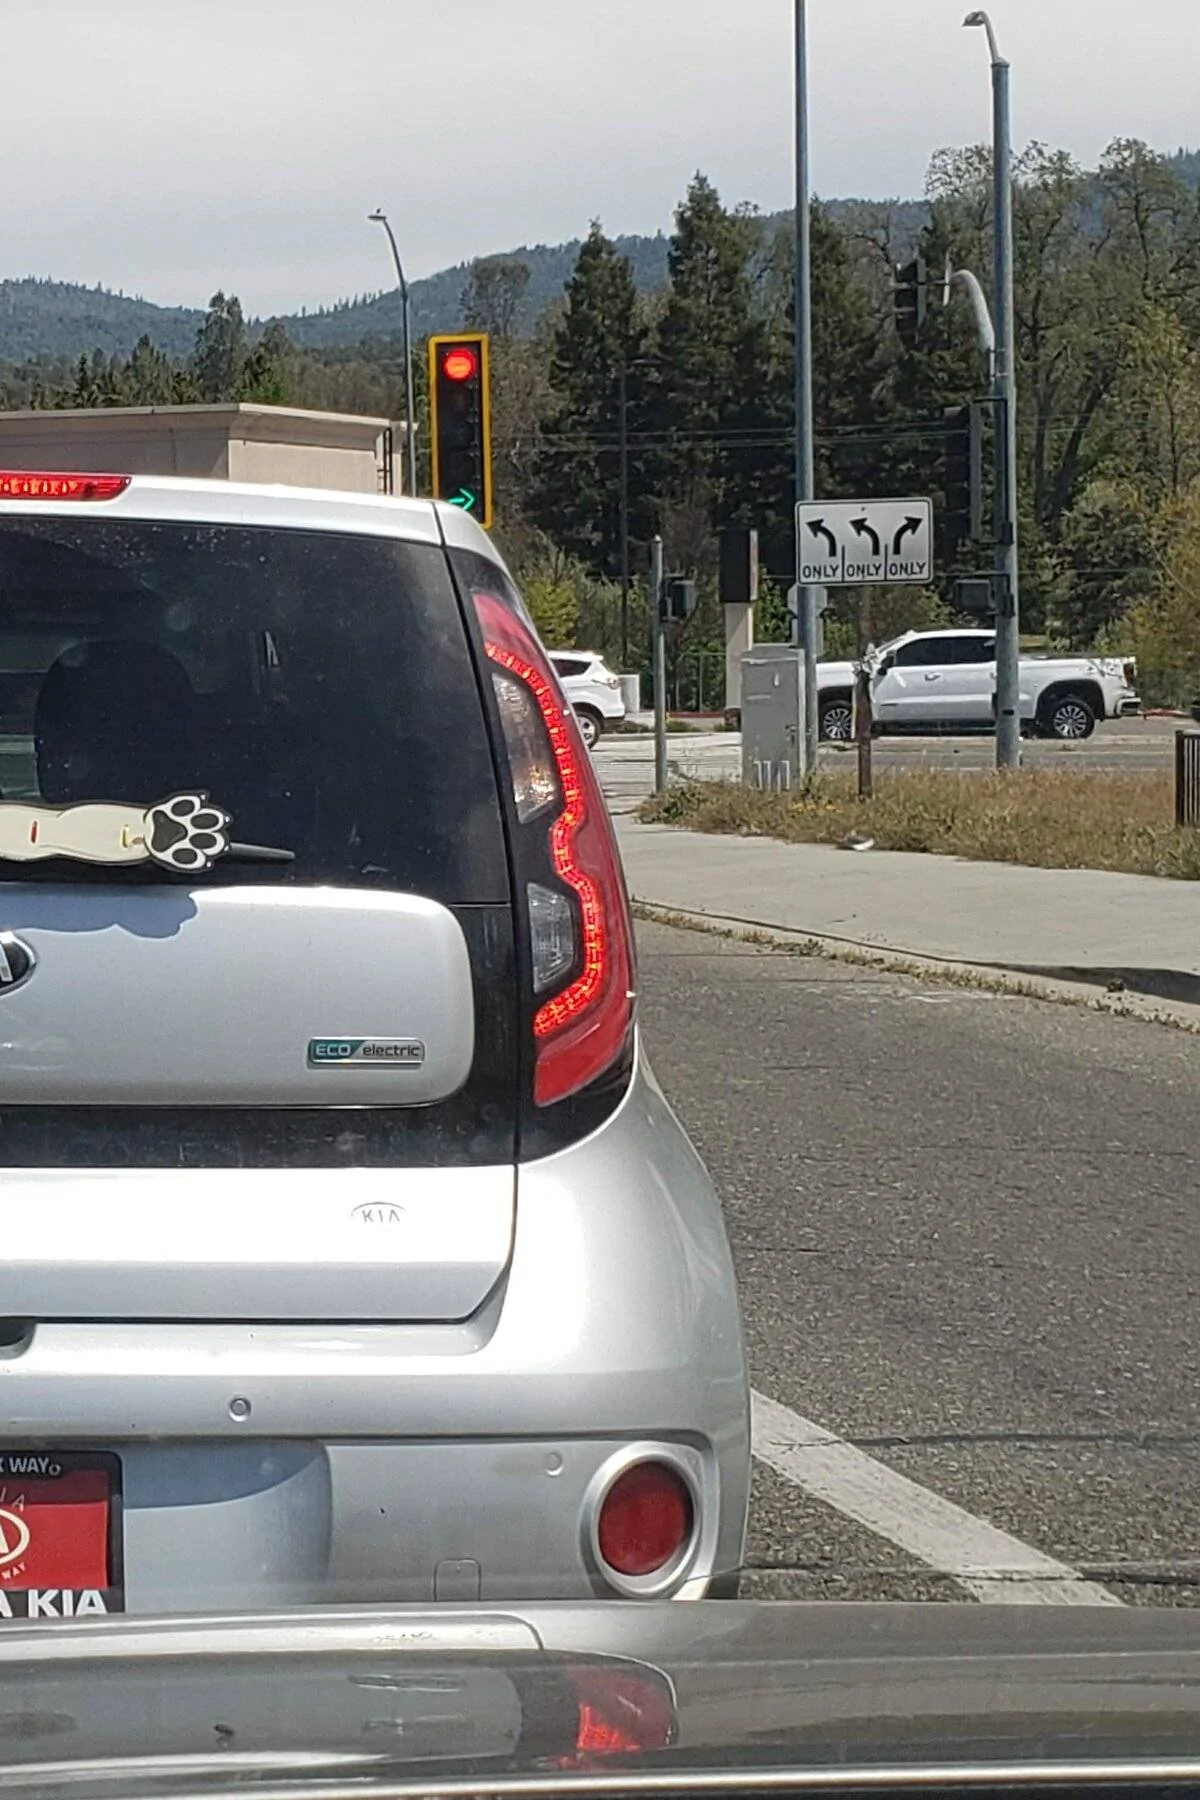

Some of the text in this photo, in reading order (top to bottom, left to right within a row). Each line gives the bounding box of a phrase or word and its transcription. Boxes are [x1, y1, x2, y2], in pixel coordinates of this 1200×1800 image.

[802, 561, 926, 579] ONLY ONLY ONLY
[315, 1043, 421, 1057] ECO electric
[361, 1209, 401, 1223] KIA
[9, 1457, 50, 1473] WAY
[1, 1561, 26, 1580] WAY
[28, 1590, 108, 1618] KIA
